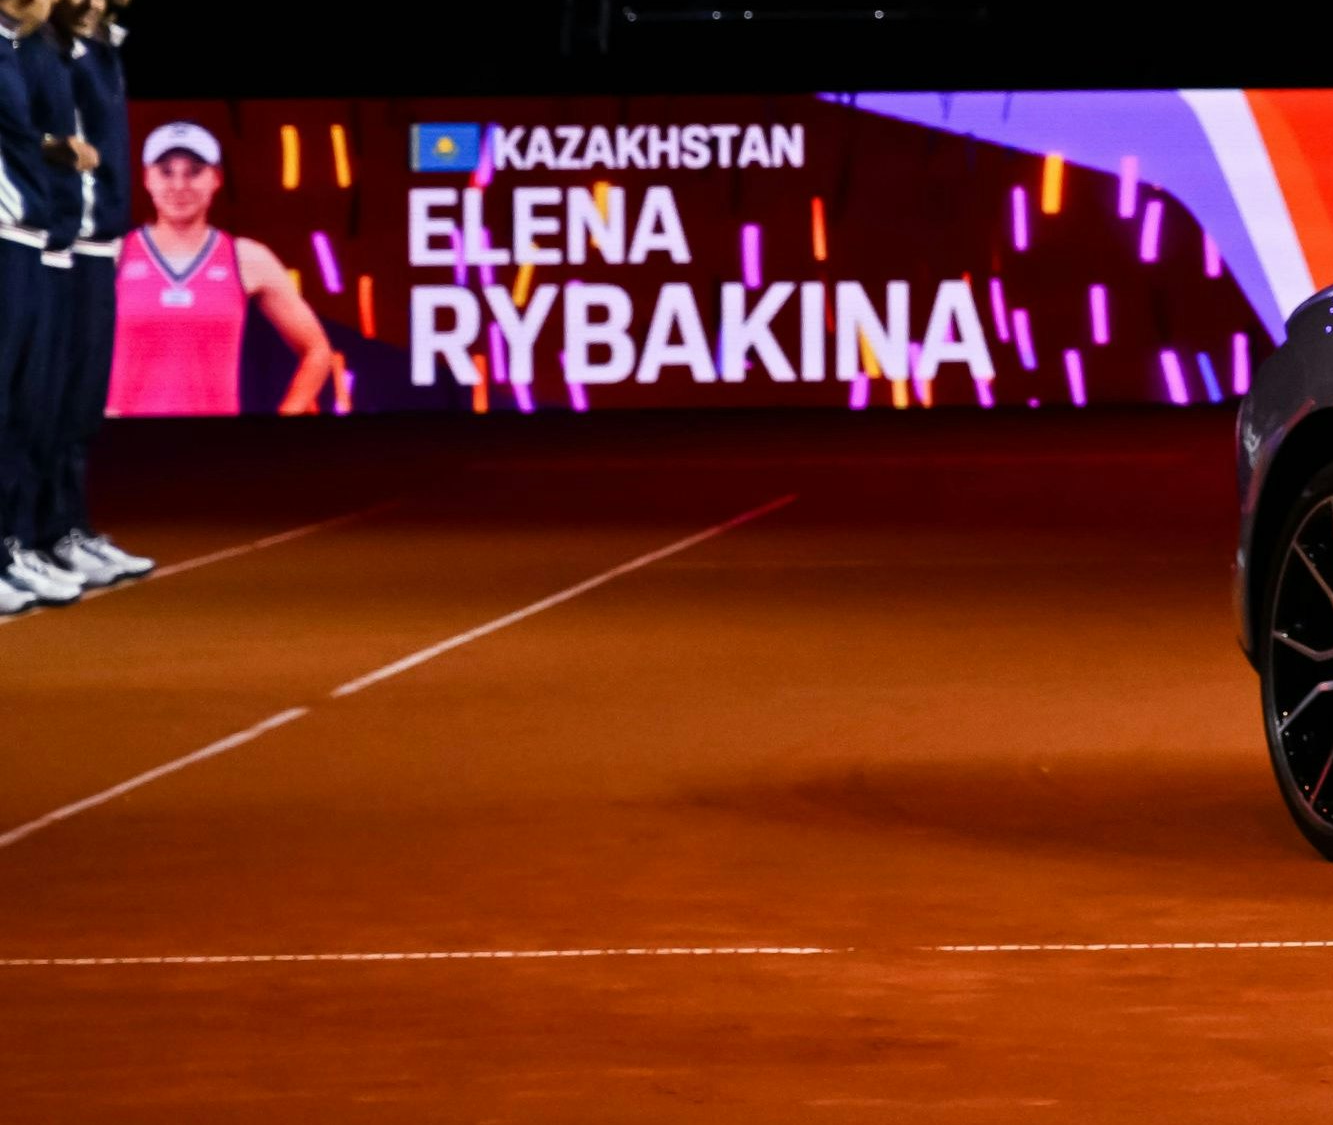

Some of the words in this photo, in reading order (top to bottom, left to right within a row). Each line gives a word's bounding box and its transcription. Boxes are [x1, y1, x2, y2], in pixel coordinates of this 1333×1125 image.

[492, 124, 805, 170] KAZAKHSTAN
[408, 185, 692, 265] ELENA
[410, 280, 996, 385] RYBAKINA
